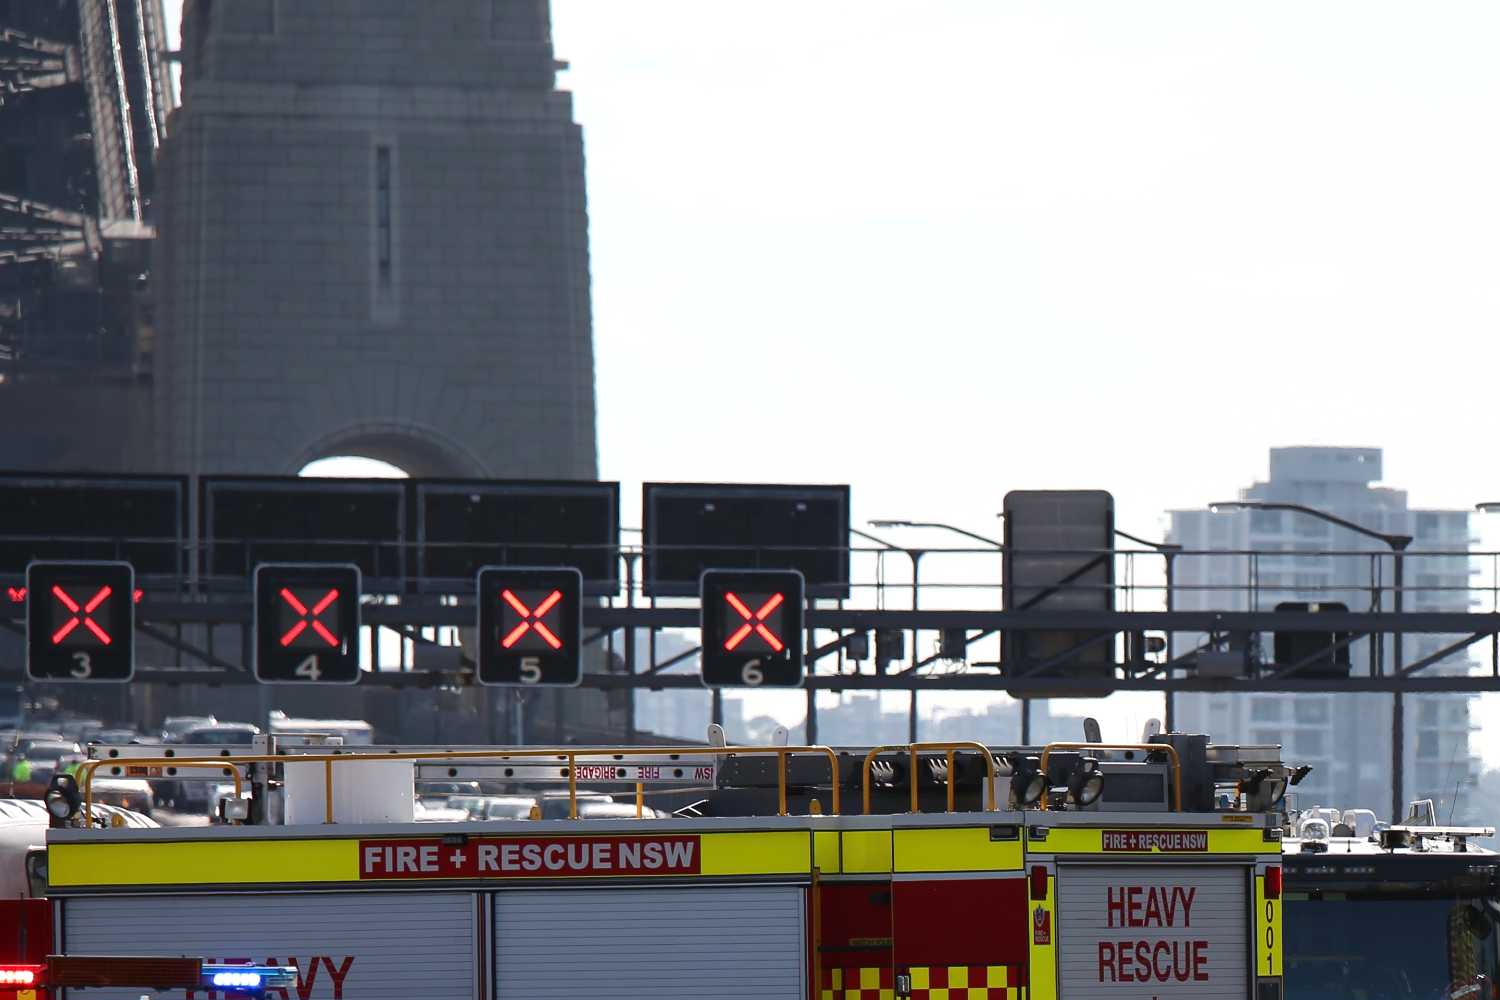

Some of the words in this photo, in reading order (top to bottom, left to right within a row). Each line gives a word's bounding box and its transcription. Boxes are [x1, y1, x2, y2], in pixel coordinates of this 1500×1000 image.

[71, 652, 92, 679] 3
[295, 654, 322, 681] 4
[520, 656, 542, 683] 5
[741, 659, 764, 685] 6
[576, 766, 615, 779] BRIGADE
[638, 767, 659, 778] FIRE
[1103, 833, 1127, 849] FIRE
[1138, 834, 1180, 849] RESCUE
[1182, 834, 1206, 848] NSW
[365, 846, 440, 873] FIRE
[478, 843, 611, 871] RESCUE
[618, 841, 695, 869] NSW
[1107, 886, 1196, 928] HEAVY
[1098, 941, 1209, 983] RESCUE
